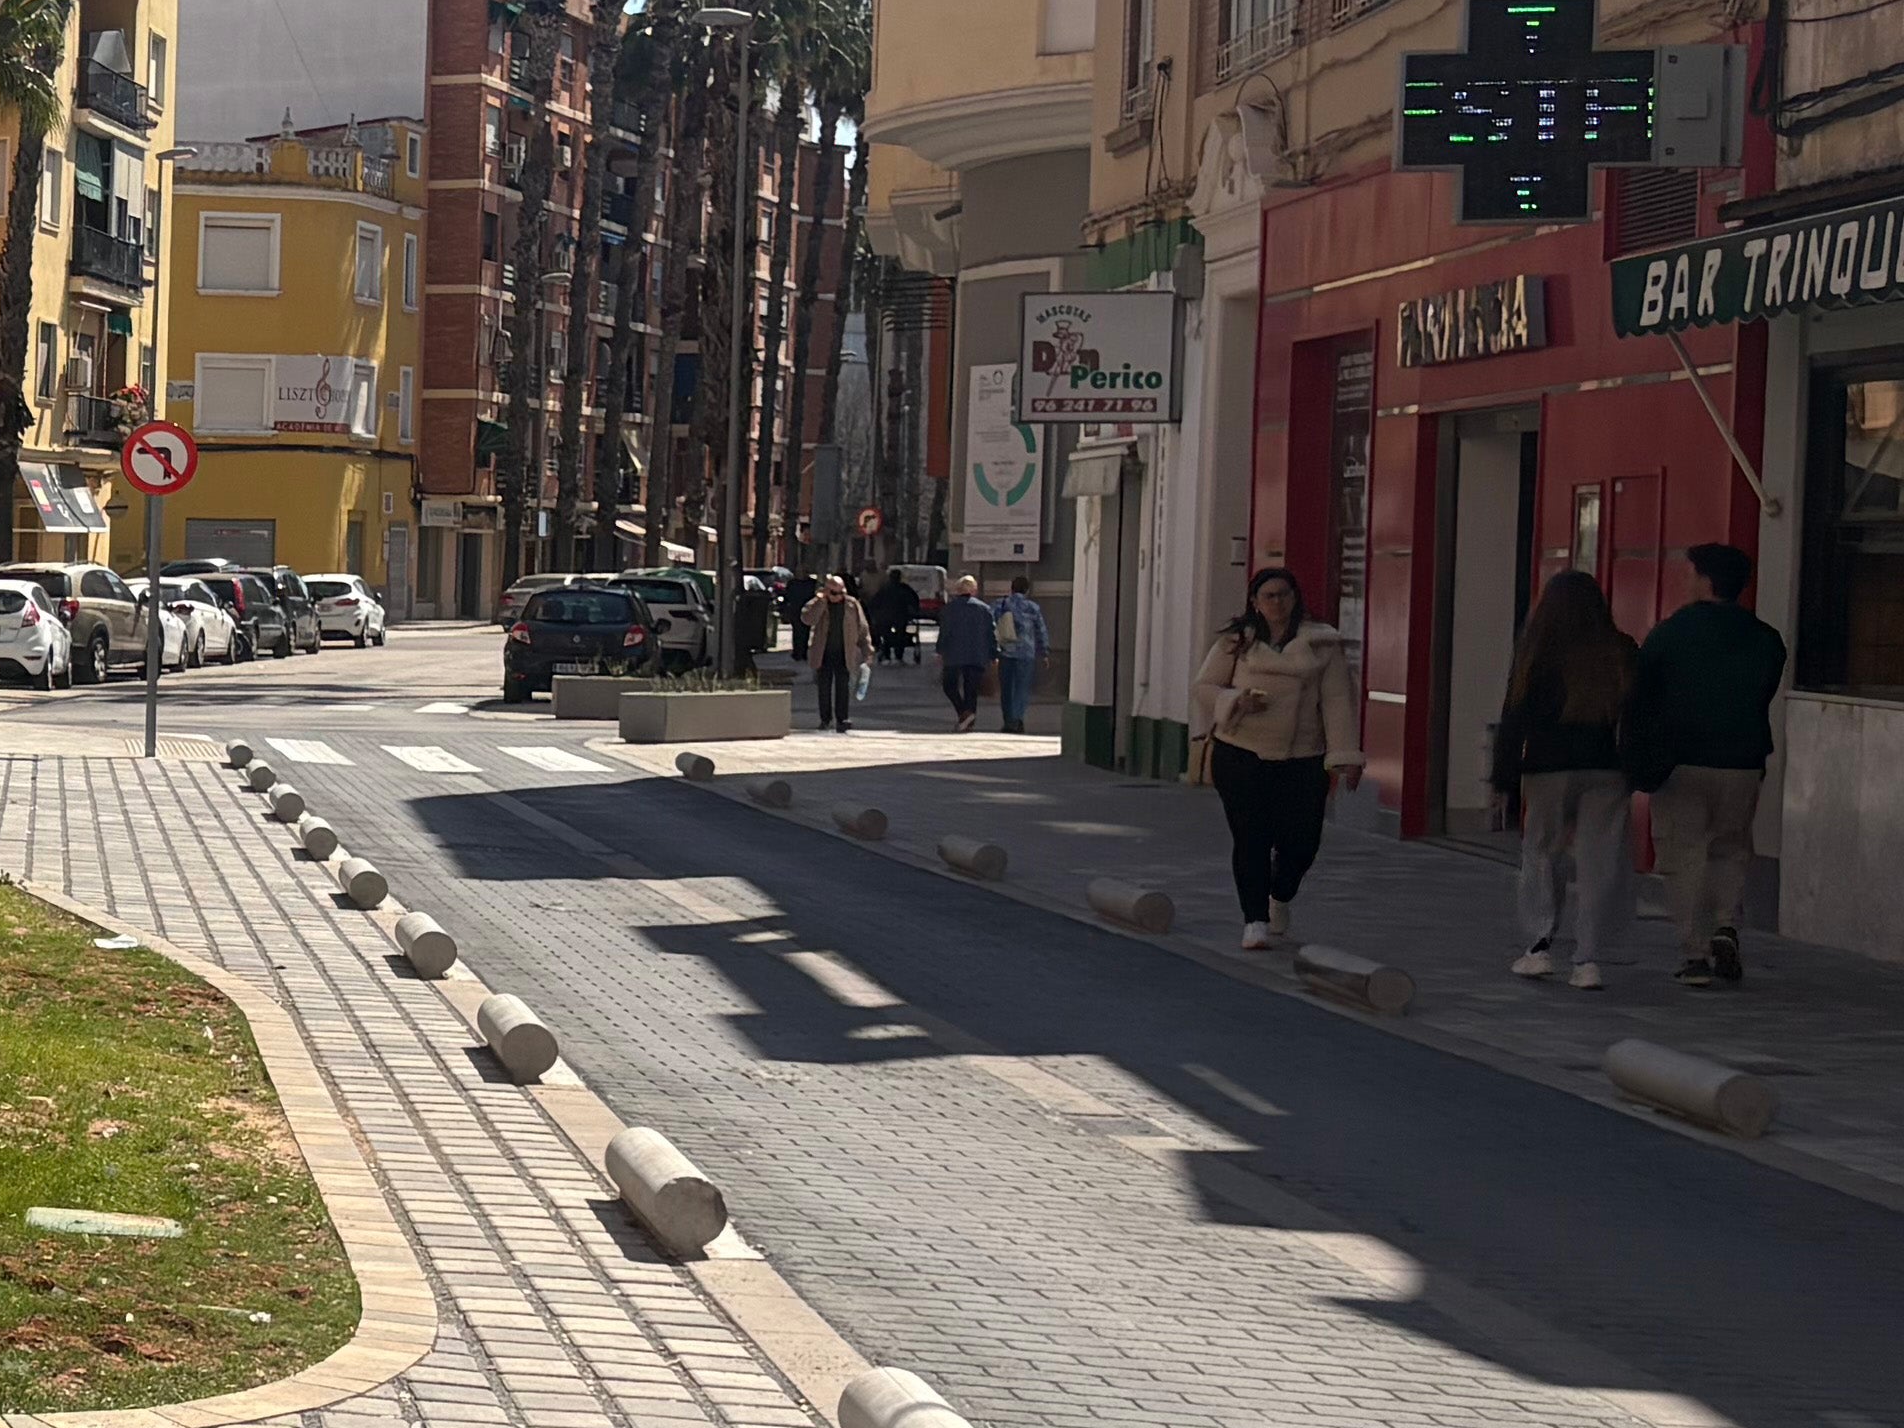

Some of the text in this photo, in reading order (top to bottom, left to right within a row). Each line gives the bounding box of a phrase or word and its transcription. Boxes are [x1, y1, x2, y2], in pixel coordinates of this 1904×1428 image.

[1639, 248, 1722, 326] BAR
[1036, 304, 1092, 324] MASCOTAS
[1032, 341, 1100, 373] Dn
[1070, 362, 1163, 390] Perico
[278, 387, 316, 402] LISZT
[1033, 400, 1154, 412] 96 241 71 96
